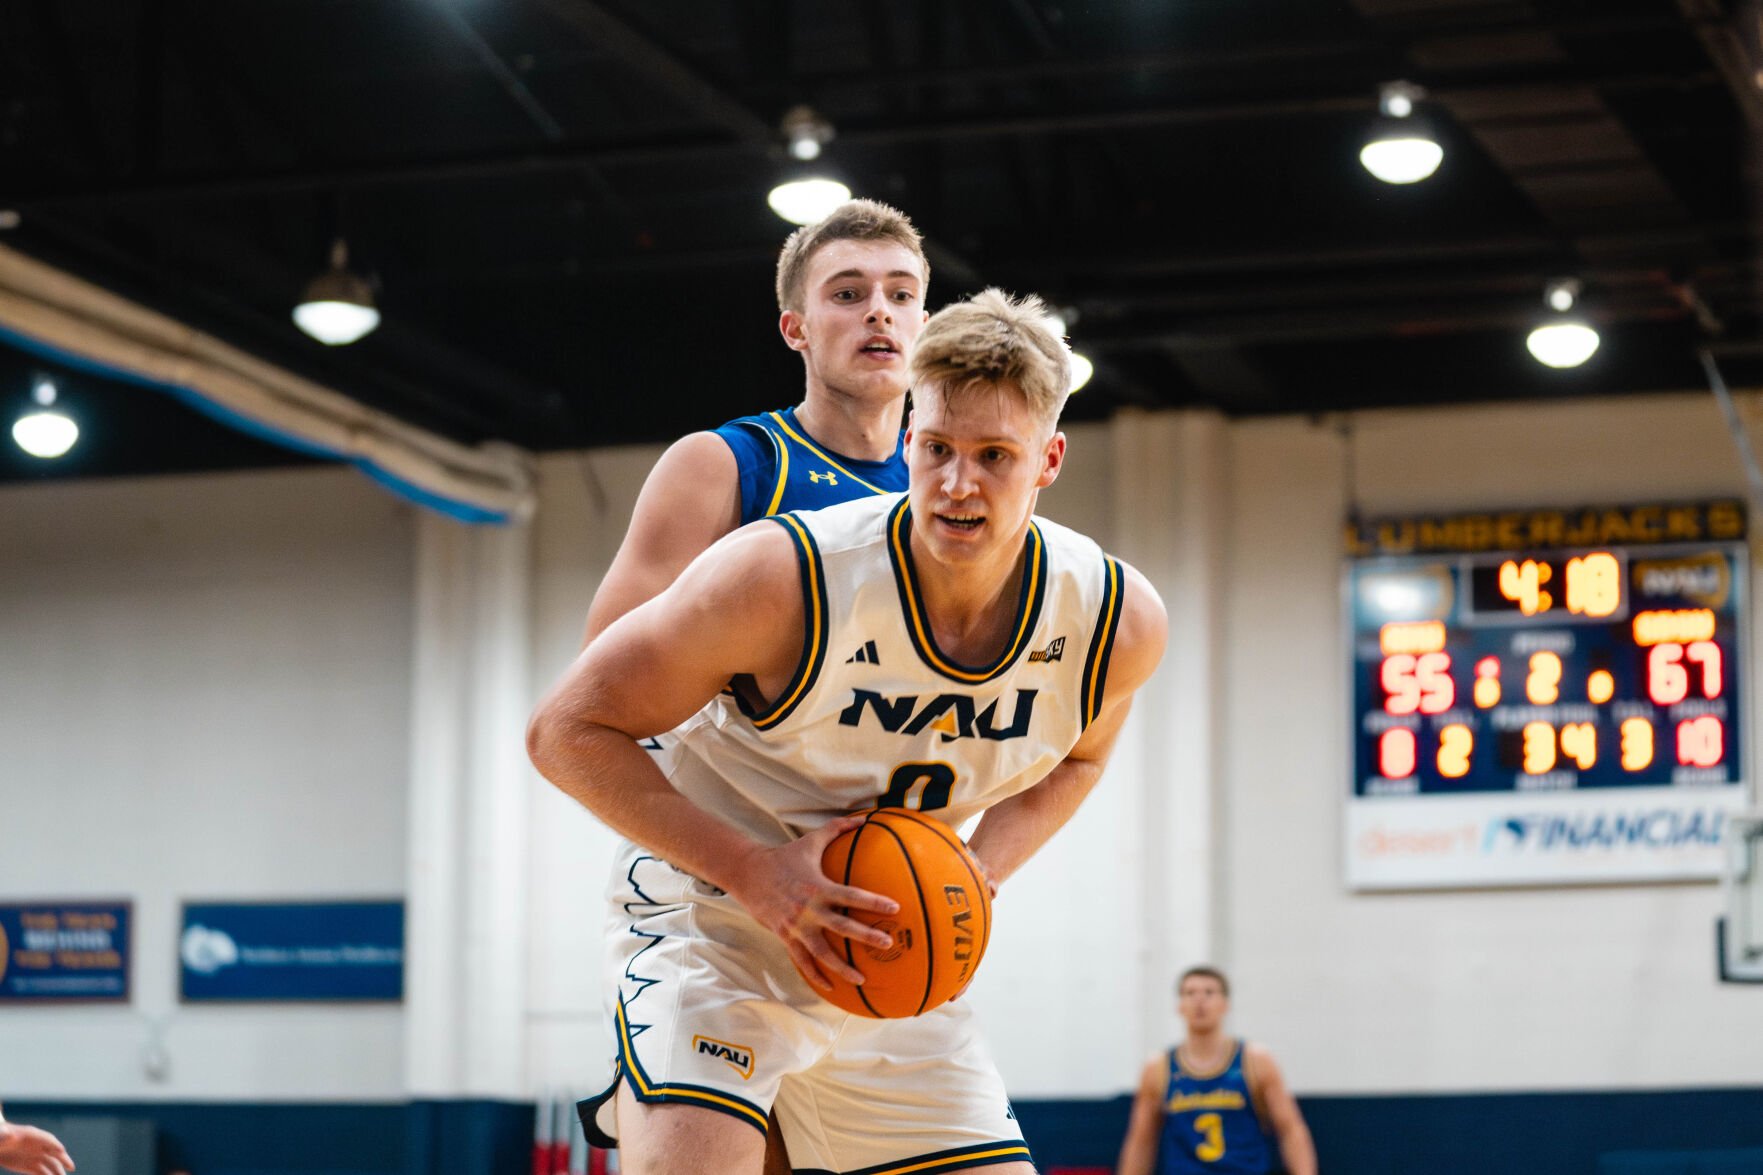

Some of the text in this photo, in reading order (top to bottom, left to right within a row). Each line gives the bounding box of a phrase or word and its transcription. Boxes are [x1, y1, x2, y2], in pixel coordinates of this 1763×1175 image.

[1344, 502, 1742, 554] LUMBERJACKS
[1499, 551, 1620, 616] 4:18
[1380, 651, 1455, 715] 55
[1525, 650, 1562, 705] 2
[1648, 640, 1722, 705] 67
[838, 688, 1039, 743] NAU
[1675, 713, 1723, 770] 10
[1436, 722, 1474, 778] 2
[1620, 716, 1655, 773] 3
[698, 1041, 749, 1068] NAU
[1193, 1112, 1226, 1163] 3
